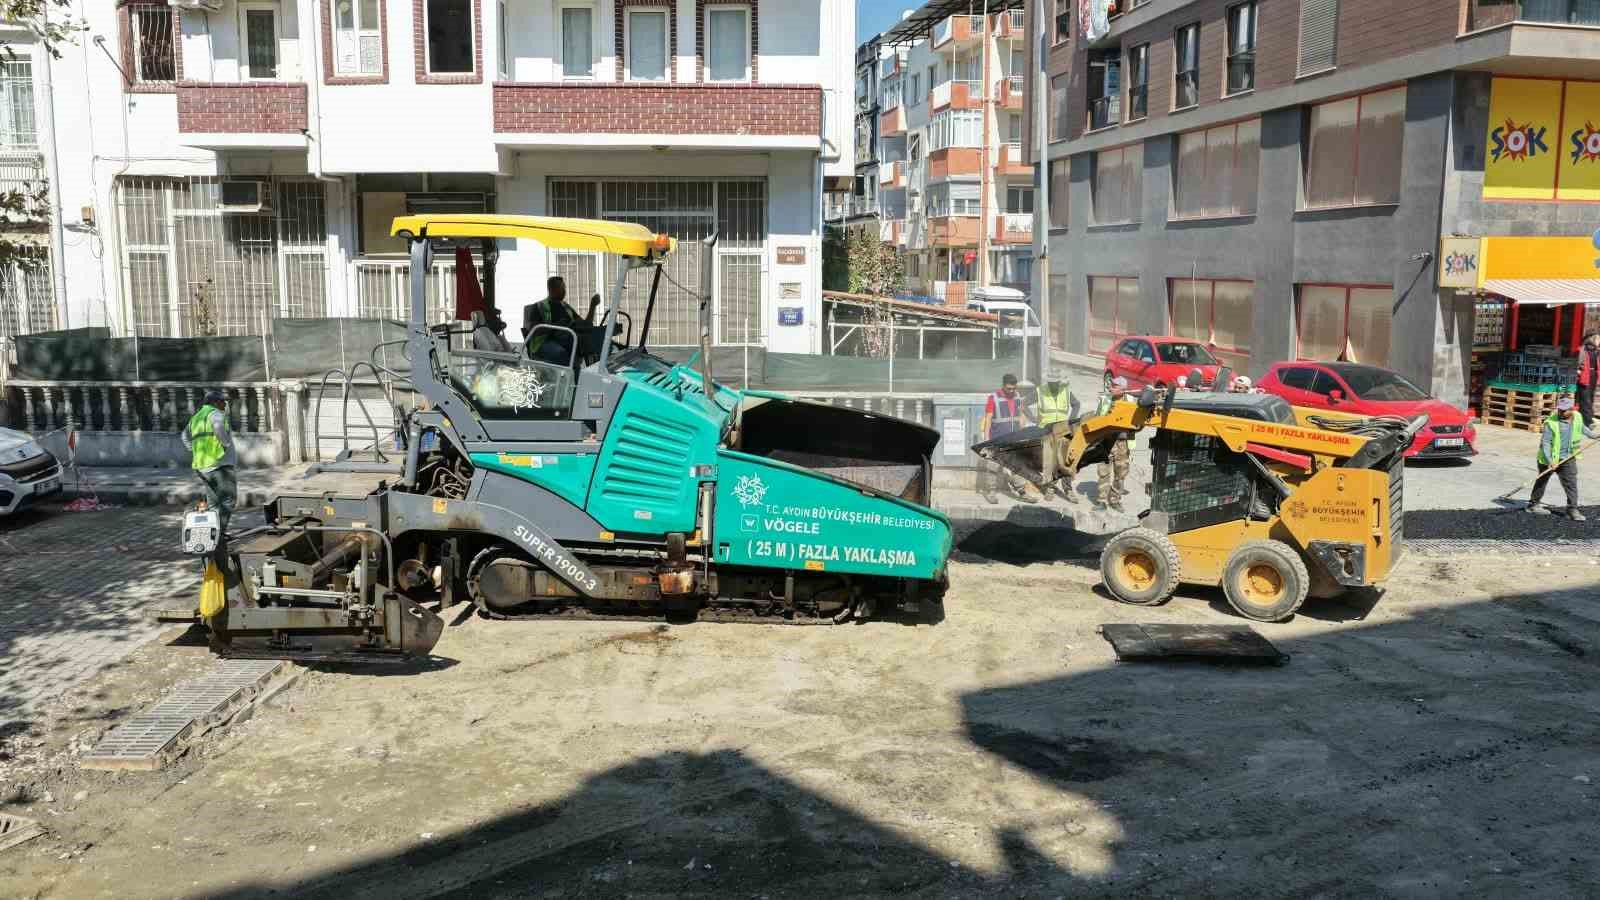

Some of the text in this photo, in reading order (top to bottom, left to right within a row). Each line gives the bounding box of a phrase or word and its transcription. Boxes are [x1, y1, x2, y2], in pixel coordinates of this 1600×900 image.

[1491, 118, 1548, 163] ŞOK
[1571, 121, 1600, 166] ŞO
[1445, 251, 1476, 277] ŞOK
[1280, 427, 1305, 438] FAZLA
[1307, 431, 1350, 445] YAKLAŞMA
[764, 517, 820, 535] VÖGELE
[783, 506, 810, 518] AYDIN
[812, 507, 881, 525] BÜYÜKŞEHİR
[883, 516, 935, 530] BELEDİYESİ
[513, 525, 597, 591] SUPER 1900-3
[756, 541, 772, 556] 25
[775, 542, 787, 557] M
[799, 543, 840, 561] FAZLA
[843, 546, 916, 568] YAKLAŞMA
